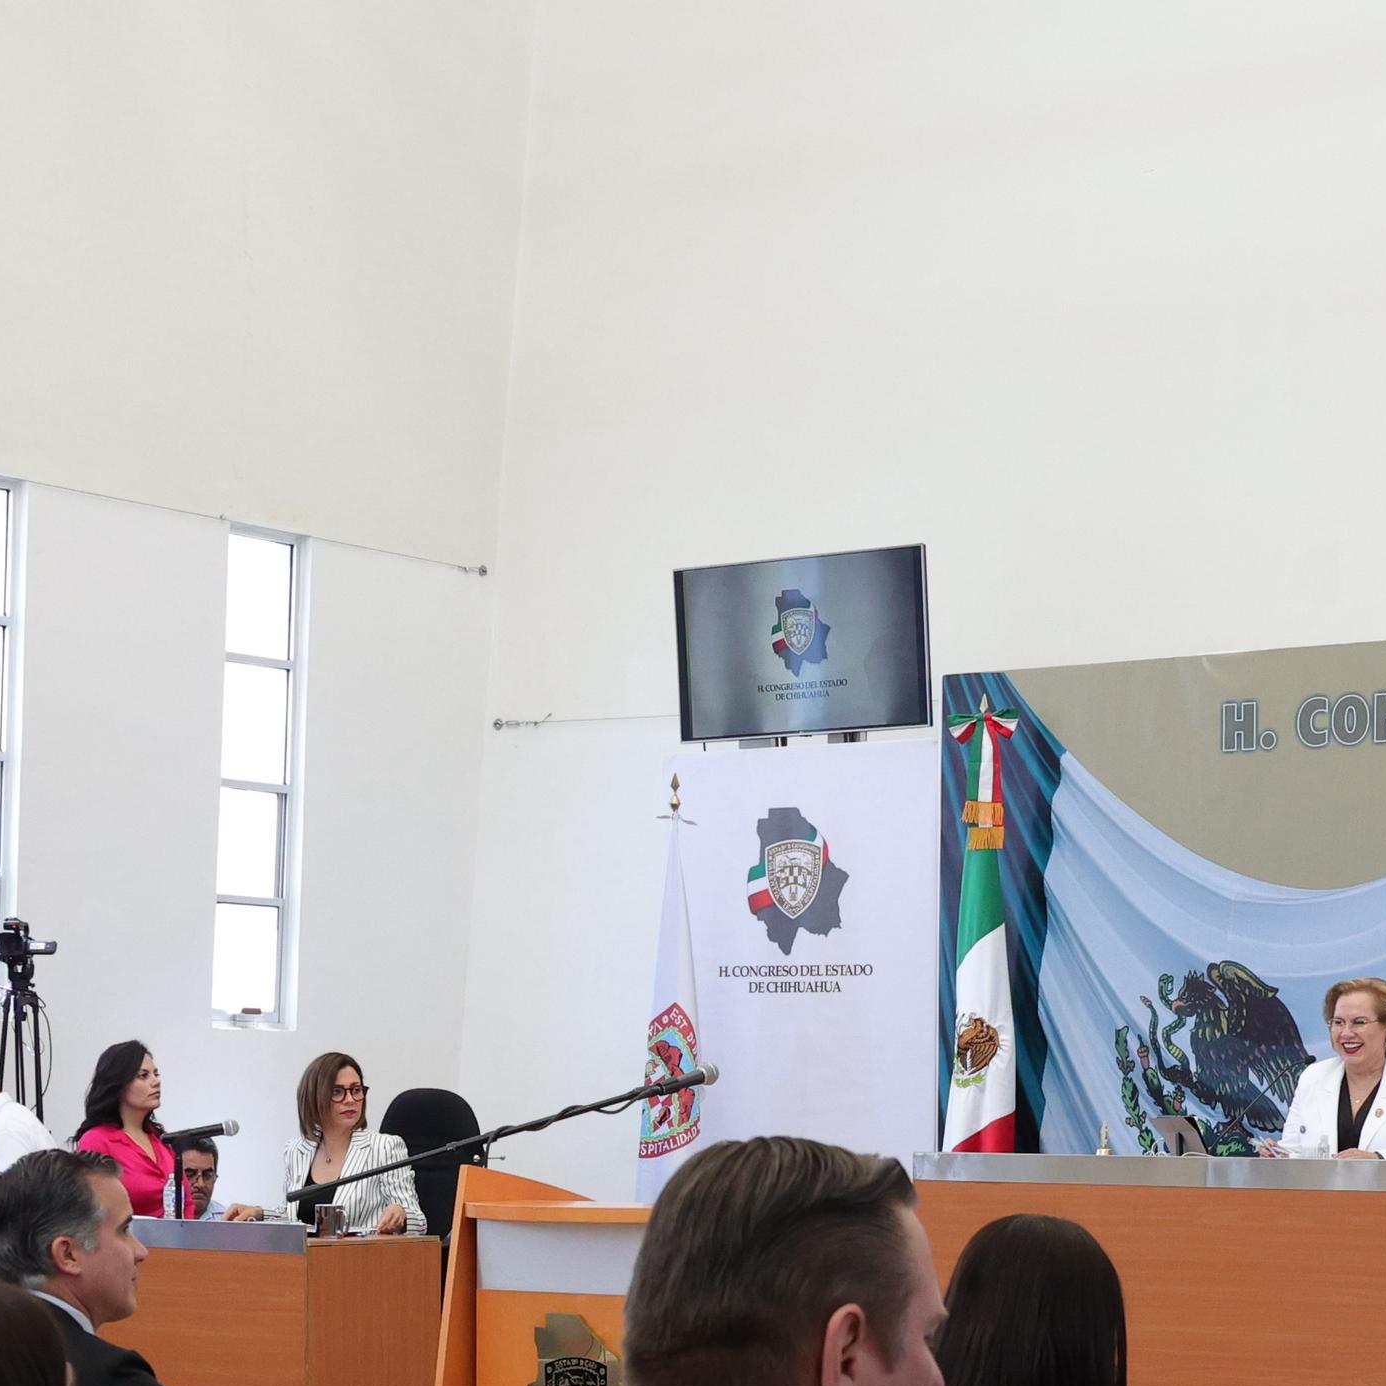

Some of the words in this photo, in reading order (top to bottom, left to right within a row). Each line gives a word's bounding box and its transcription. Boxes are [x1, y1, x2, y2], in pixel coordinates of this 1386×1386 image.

[765, 682, 804, 692] CONGRESO
[805, 681, 819, 689] DEL
[819, 678, 848, 688] ESTADO
[775, 692, 785, 701] DE
[785, 690, 830, 700] CHIHUAHUA
[1222, 701, 1278, 752] H.
[719, 966, 731, 978] H.
[732, 965, 799, 977] CONGRESO
[800, 964, 824, 977] DEL
[825, 964, 874, 977] ESTADO
[749, 981, 764, 993] DE
[766, 981, 842, 993] CHIHUAHUA
[640, 1126, 697, 1155] SPITALIDAD
